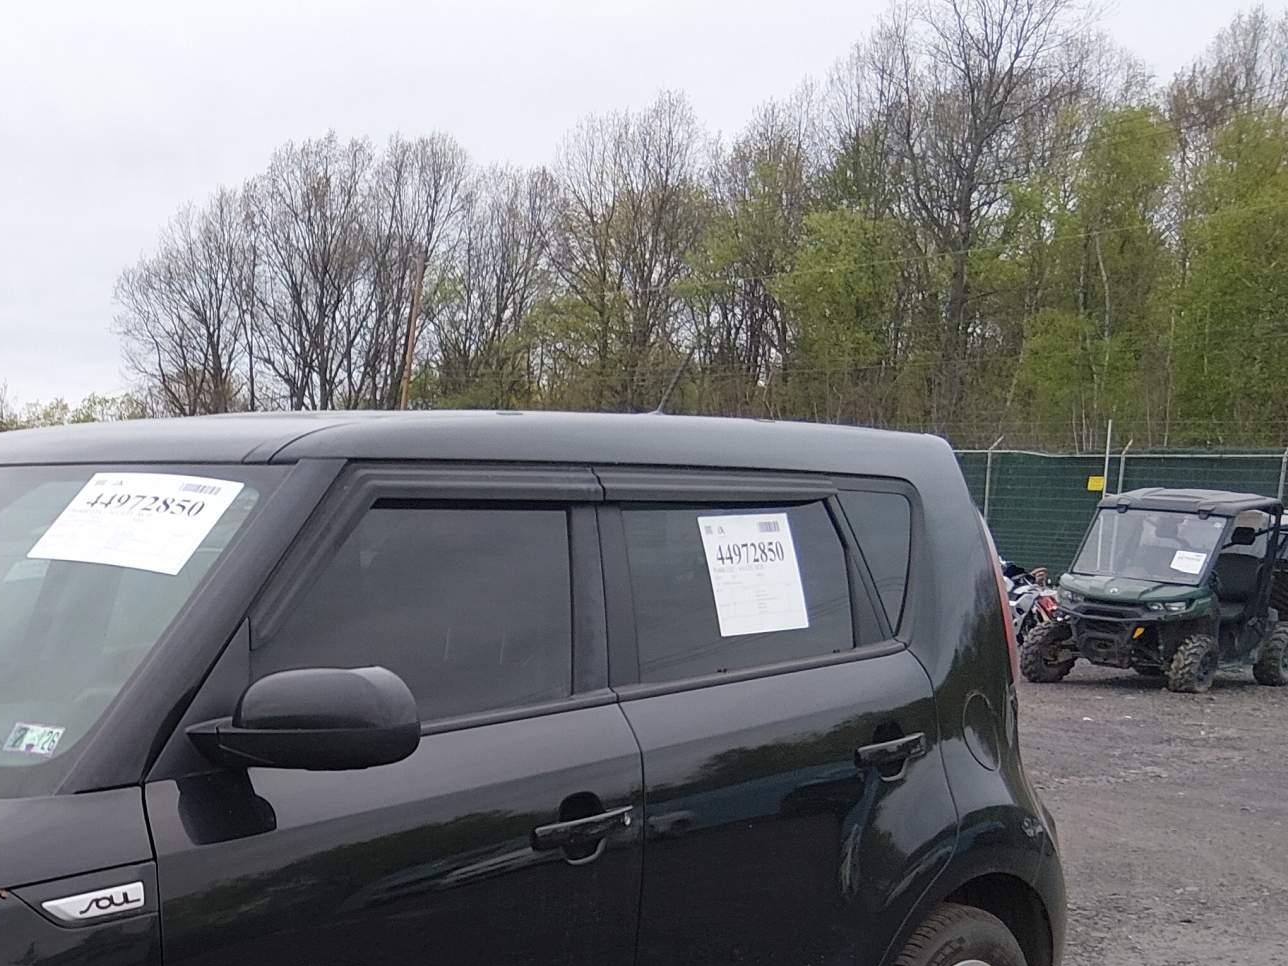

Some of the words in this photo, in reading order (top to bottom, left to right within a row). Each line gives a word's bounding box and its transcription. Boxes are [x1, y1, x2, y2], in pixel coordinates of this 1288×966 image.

[86, 492, 206, 519] 44972850
[717, 541, 786, 566] 44972850
[79, 891, 141, 915] SOUL
